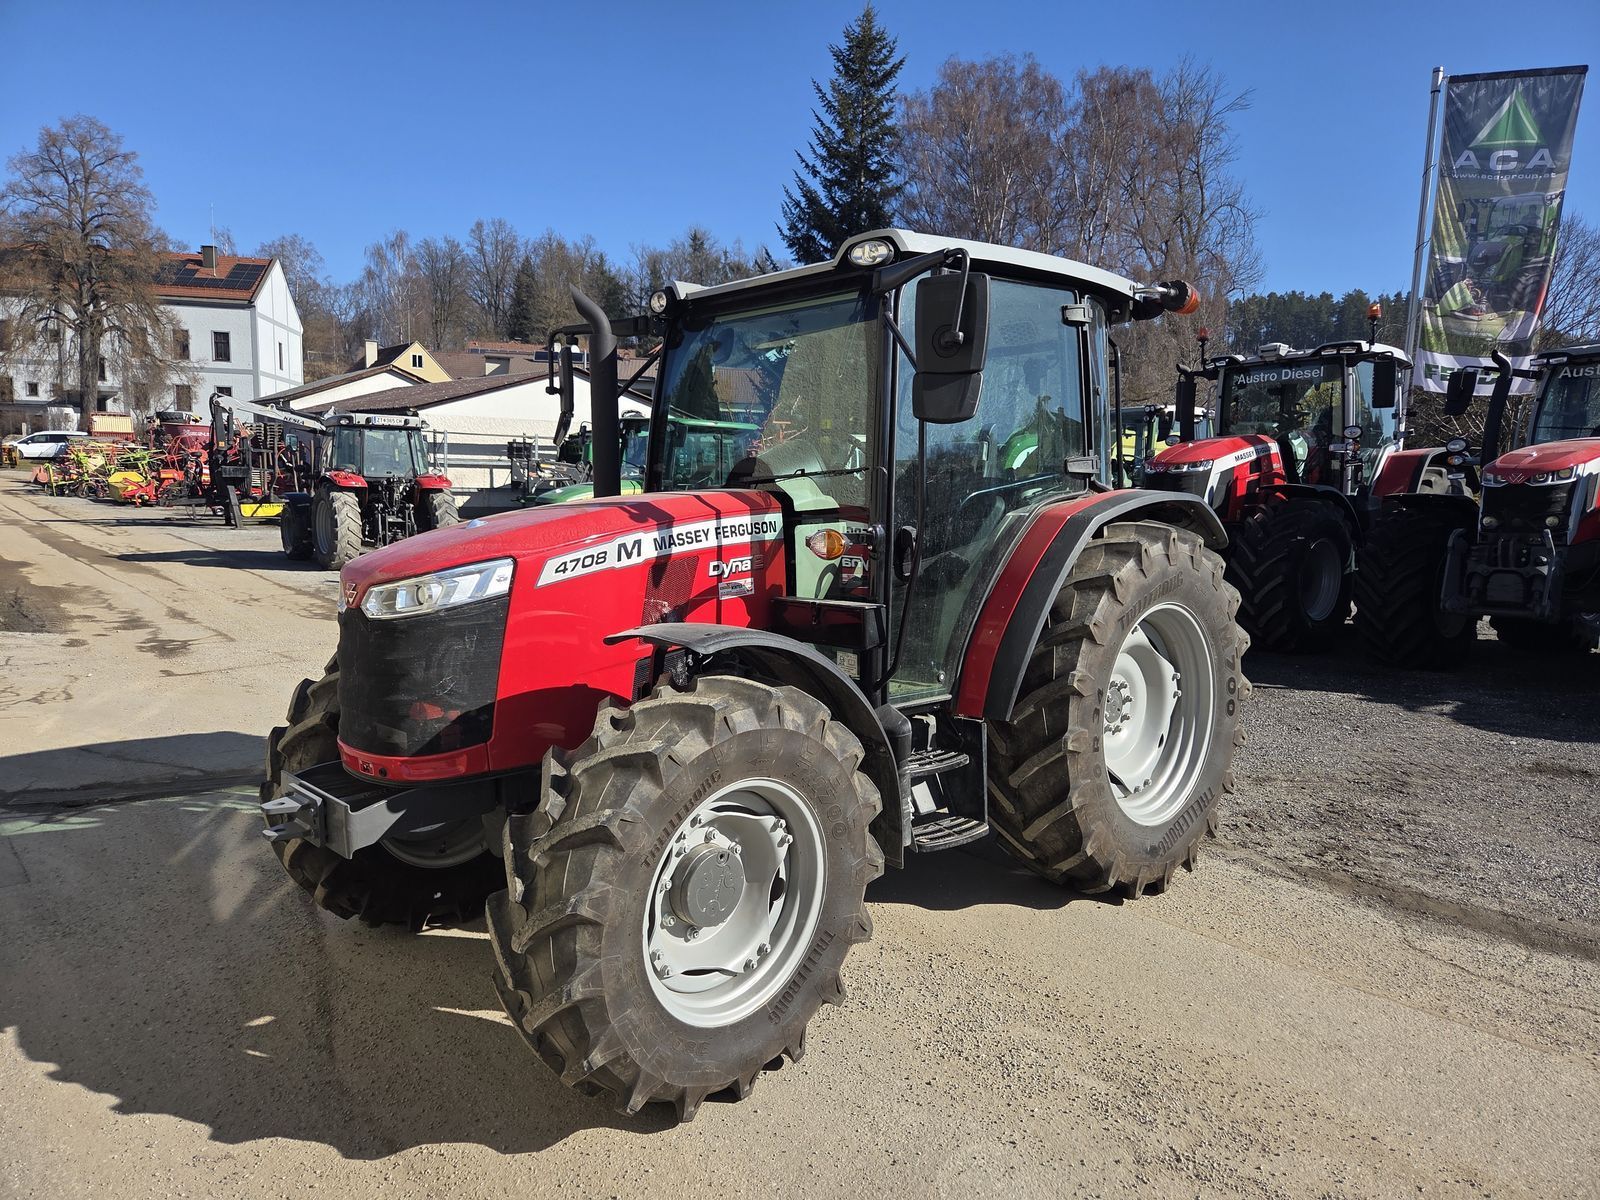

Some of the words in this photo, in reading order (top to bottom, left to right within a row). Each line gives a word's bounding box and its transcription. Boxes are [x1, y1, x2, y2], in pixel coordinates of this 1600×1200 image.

[1455, 148, 1556, 170] ACA
[1237, 372, 1278, 384] Austro
[1281, 366, 1324, 380] Diesel
[1234, 449, 1255, 462] MASSEY
[554, 550, 608, 574] 4708
[617, 538, 642, 562] M
[653, 528, 710, 552] MASSEY
[715, 520, 777, 541] FERGUSON
[768, 930, 837, 1025] TRELLEBORG
